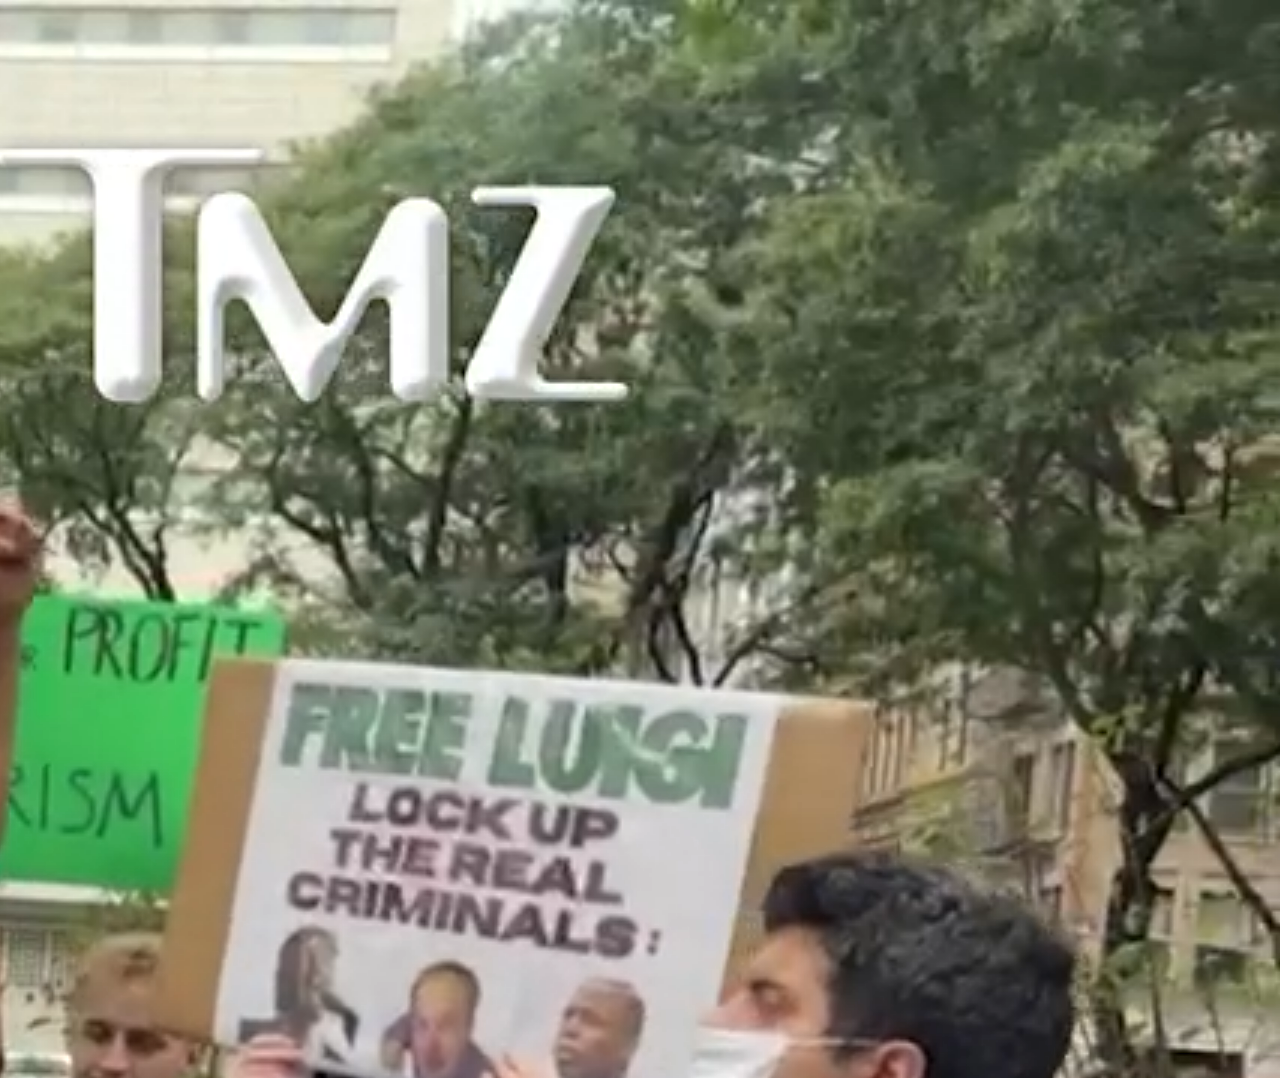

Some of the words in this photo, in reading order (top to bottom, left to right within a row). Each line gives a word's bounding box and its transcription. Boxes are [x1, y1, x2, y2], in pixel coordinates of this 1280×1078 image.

[64, 607, 264, 682] PROFIT
[280, 682, 471, 785] FREE
[488, 695, 749, 809] LUIGI
[349, 783, 513, 841] LOCK
[528, 804, 620, 848] UP
[330, 830, 443, 881] THE
[447, 842, 622, 905] REAL
